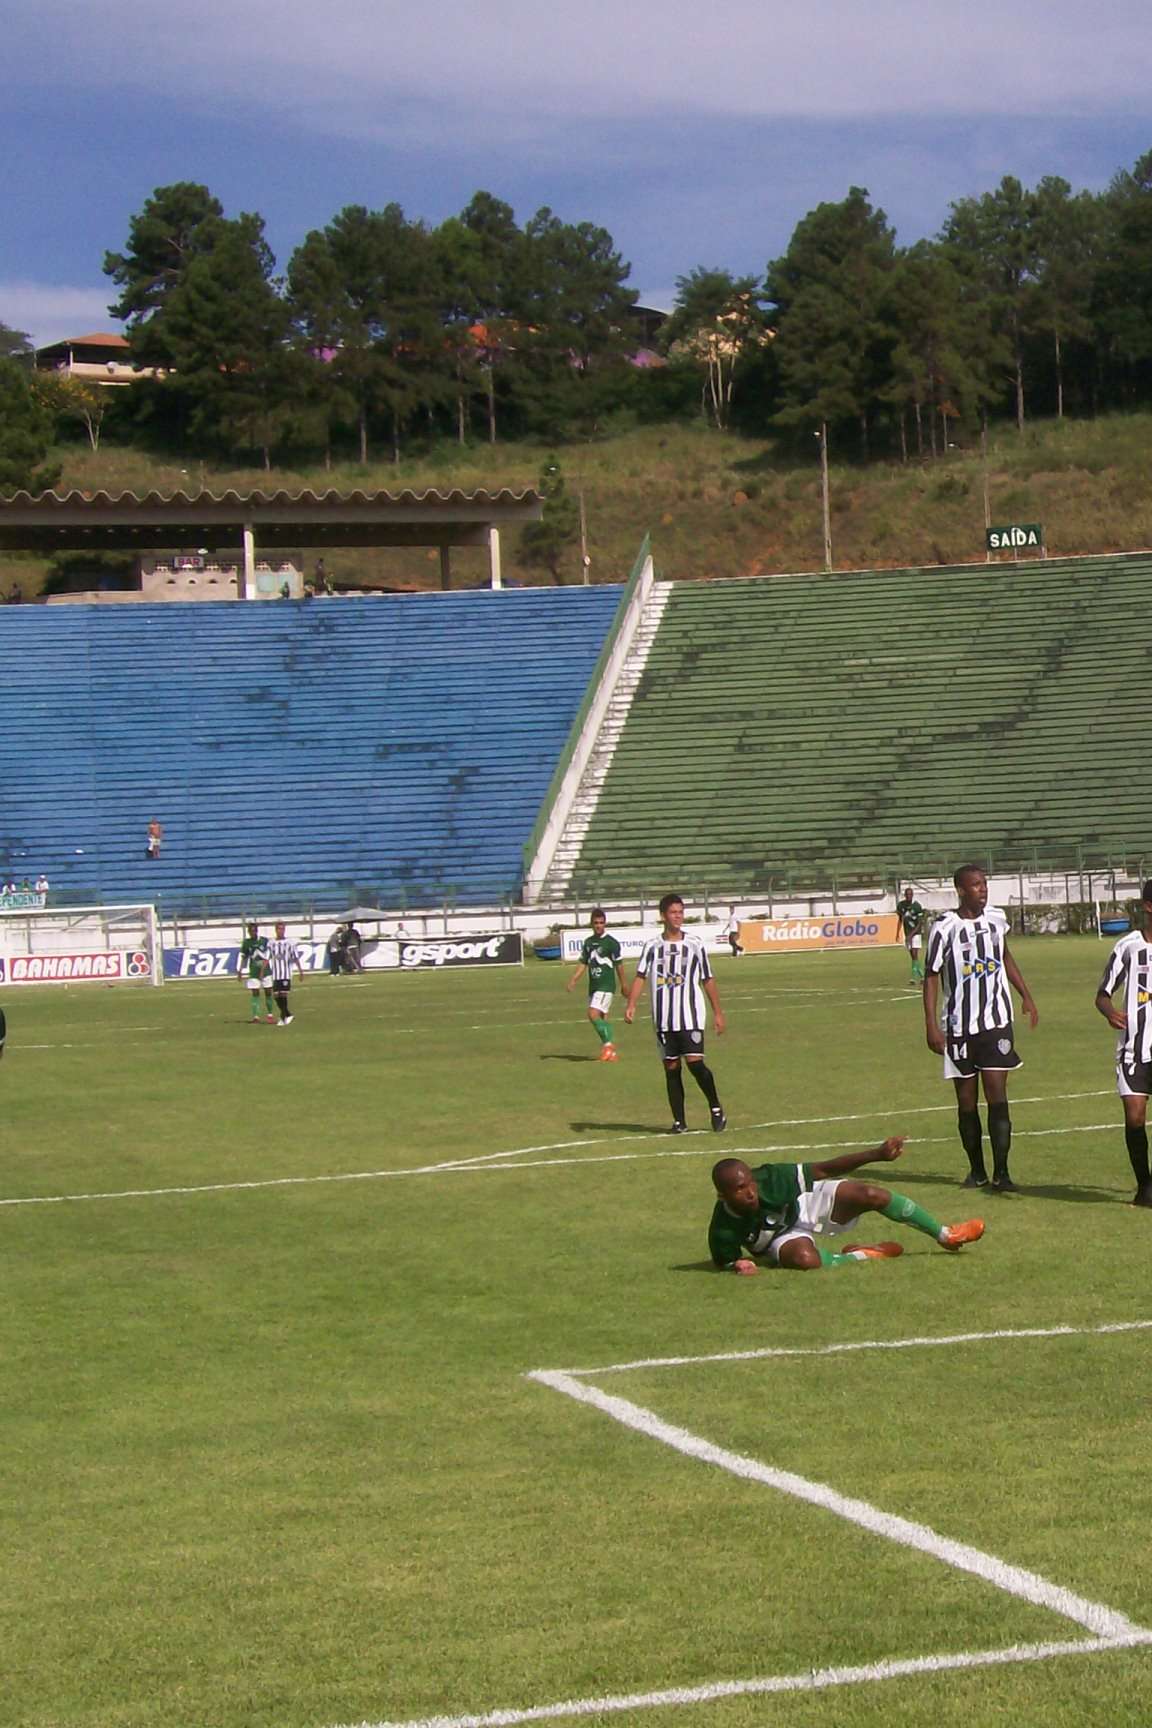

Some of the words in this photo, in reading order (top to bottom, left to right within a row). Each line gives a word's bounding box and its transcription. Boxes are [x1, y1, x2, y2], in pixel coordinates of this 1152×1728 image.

[990, 527, 1038, 547] SAÍDA
[179, 949, 230, 976] Faz
[402, 938, 500, 965] gsport
[12, 955, 119, 979] BAHAMAS
[952, 1042, 968, 1060] 14
